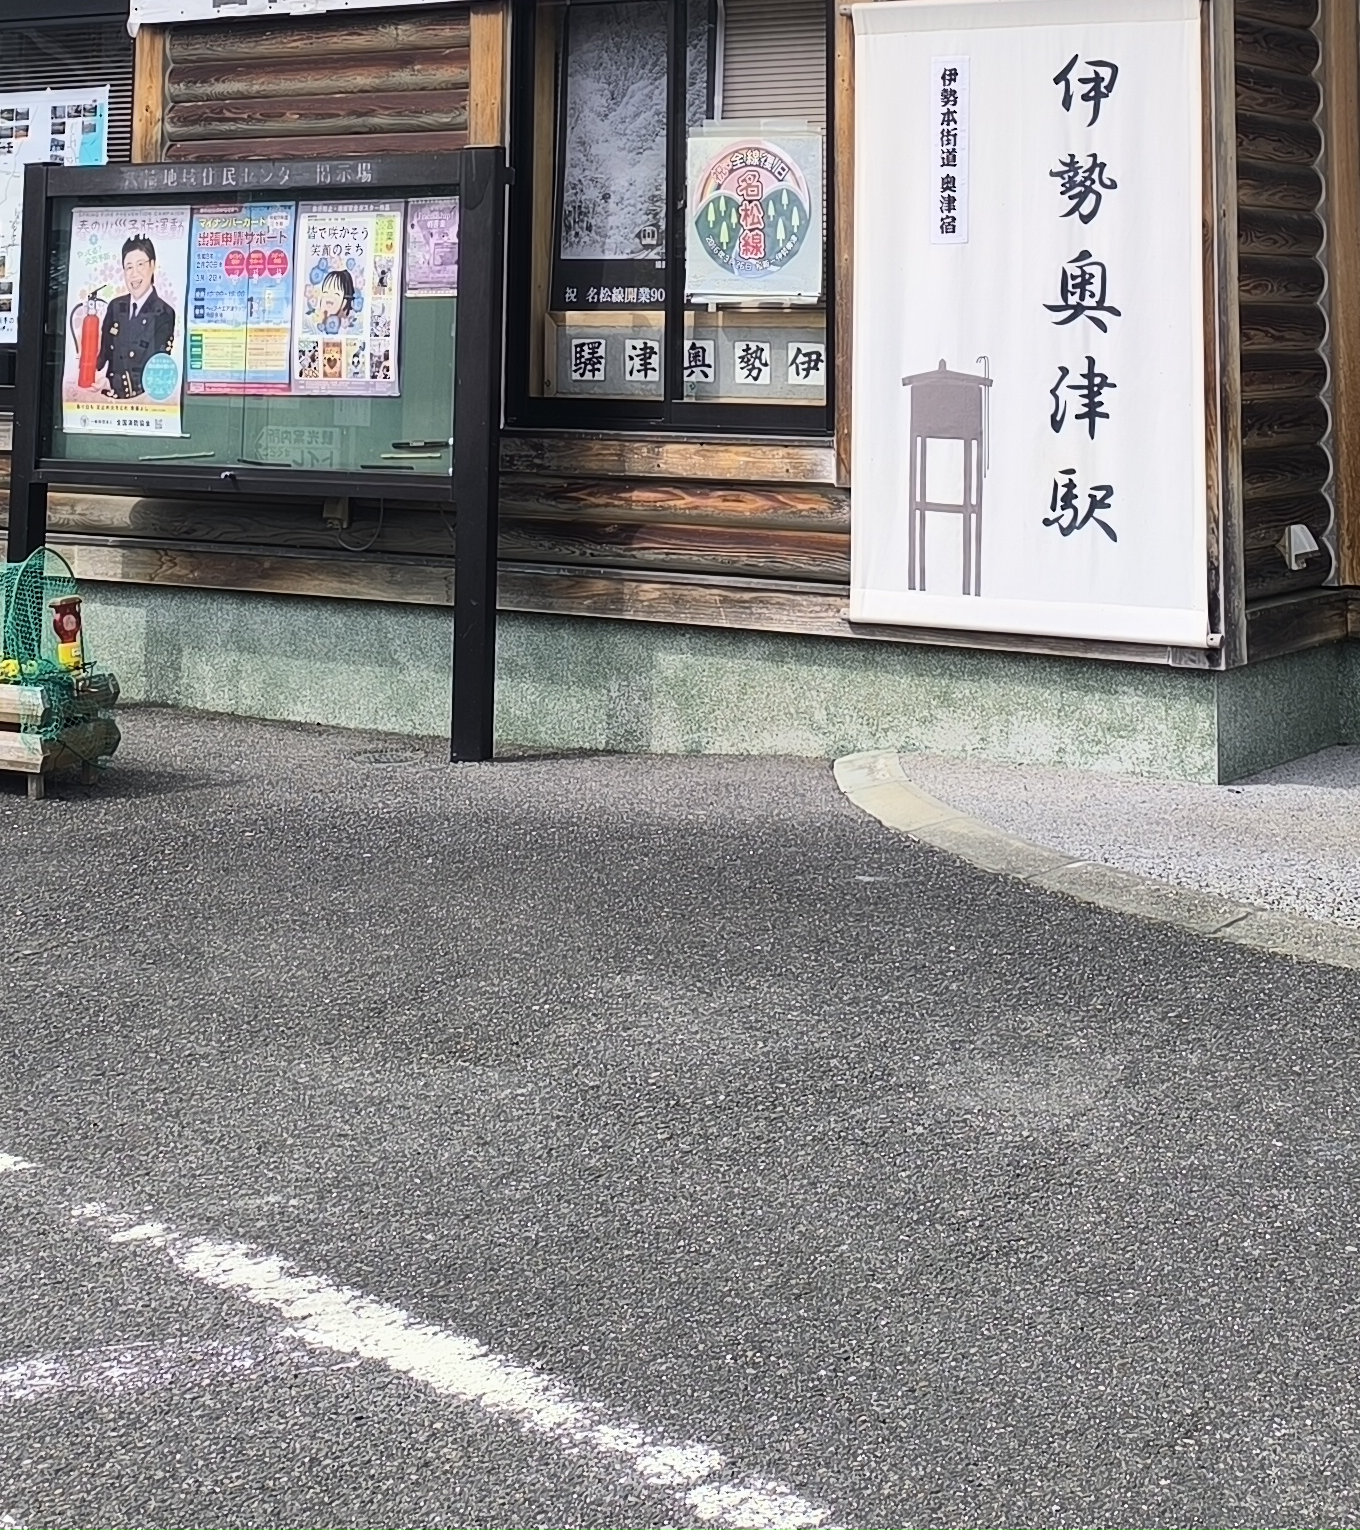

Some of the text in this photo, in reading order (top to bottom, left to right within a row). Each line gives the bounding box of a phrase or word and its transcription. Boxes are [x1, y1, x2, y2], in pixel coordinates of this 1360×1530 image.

[938, 67, 959, 236] 伊勢本街道 奥津宿
[198, 217, 267, 229] マイナンバーカード
[736, 170, 767, 260] 名松線
[198, 230, 288, 247] 出張申請サポート
[307, 226, 369, 240] 皆で咲かそう
[310, 244, 364, 258] 笑顔のまち
[564, 287, 577, 302] 祝
[1042, 52, 1122, 544] 伊勢奥津駅
